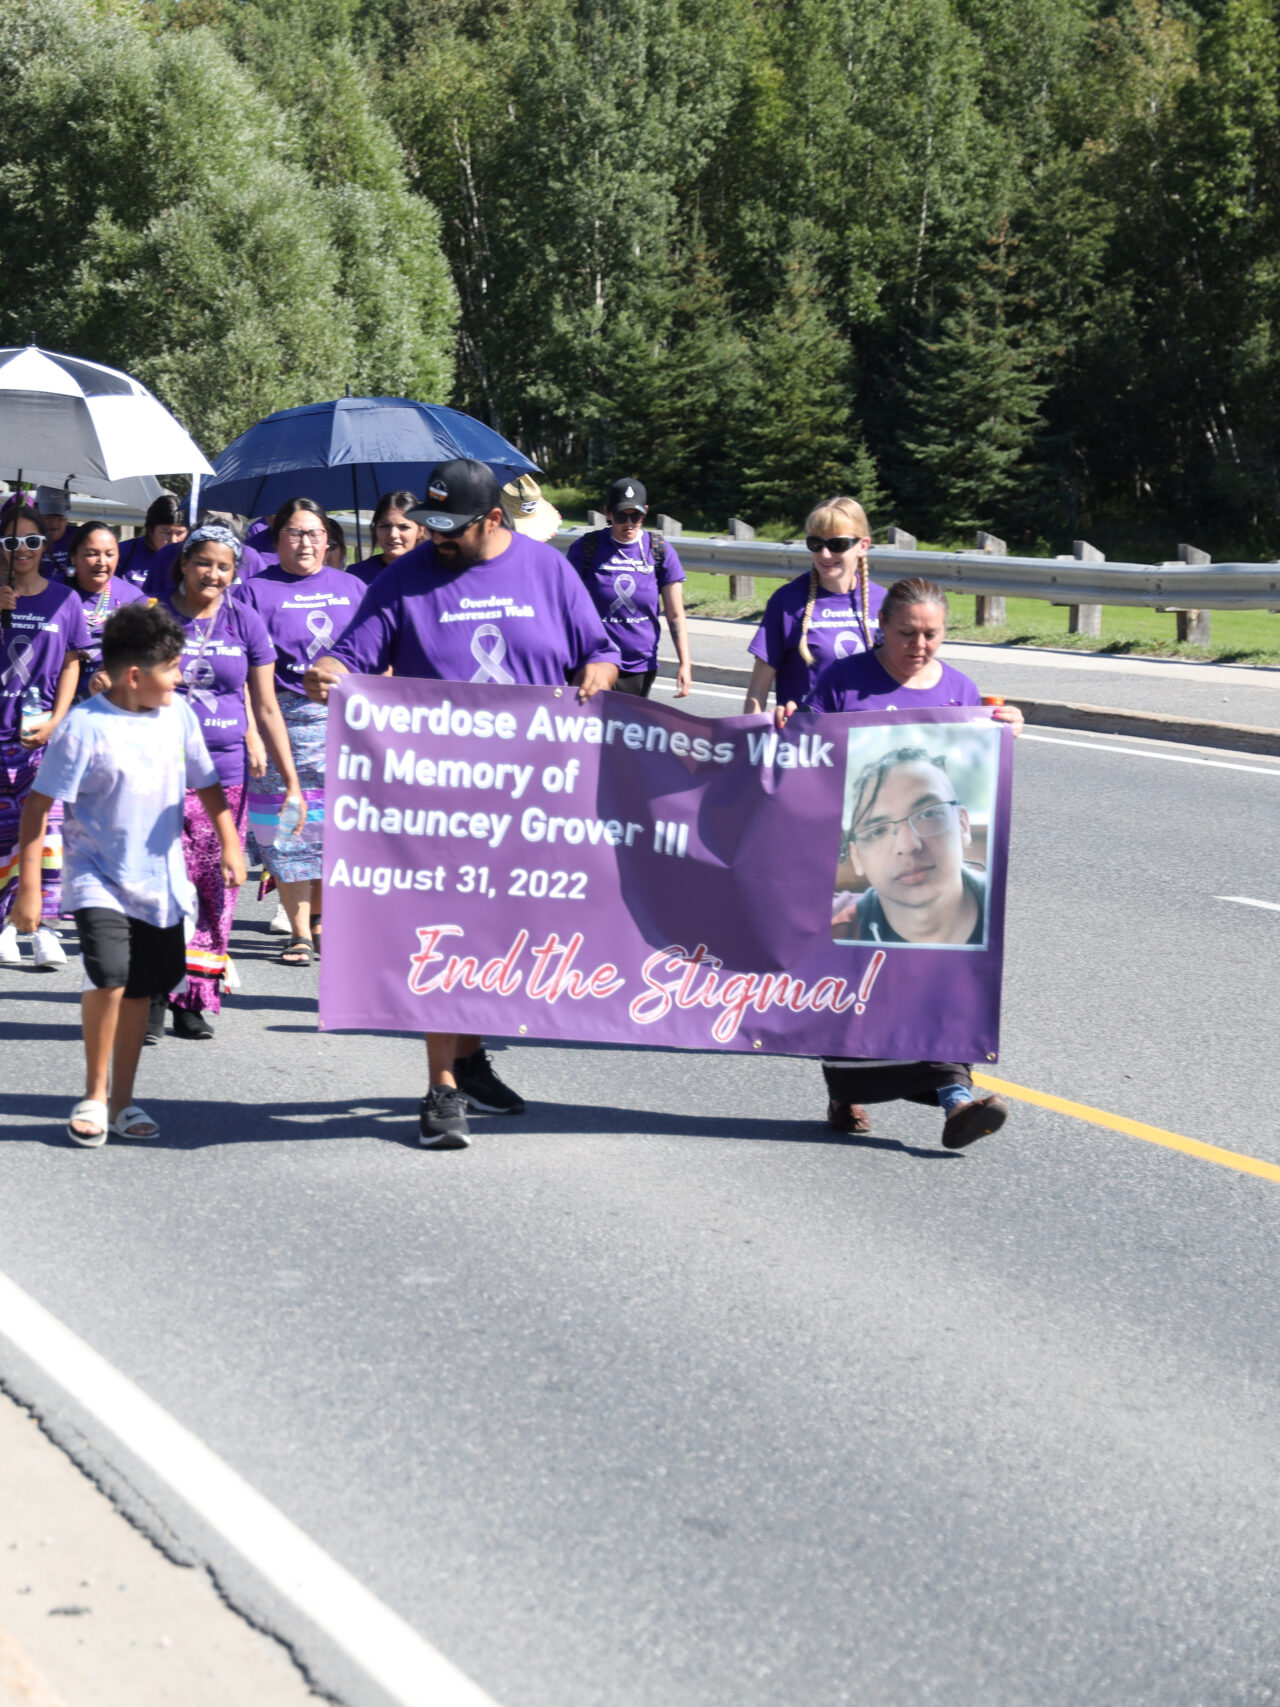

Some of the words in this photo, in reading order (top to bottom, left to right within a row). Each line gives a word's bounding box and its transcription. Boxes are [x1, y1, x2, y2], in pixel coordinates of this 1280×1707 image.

[439, 610, 502, 623] Awareness
[504, 605, 535, 617] Walk
[460, 596, 514, 609] Overdose
[344, 693, 517, 740] Overdose
[526, 705, 735, 764] Awareness
[747, 732, 835, 769] Walk
[337, 744, 371, 781] in
[383, 747, 534, 799] Memory
[542, 758, 581, 794] of
[333, 795, 512, 848] Chauncey
[520, 806, 645, 847] Grover
[653, 819, 690, 859] III
[329, 858, 447, 896] August
[455, 865, 497, 899] 31,
[507, 868, 588, 900] 2022
[407, 923, 529, 996] End
[524, 930, 625, 1004] the
[629, 944, 886, 1043] Stigma!
